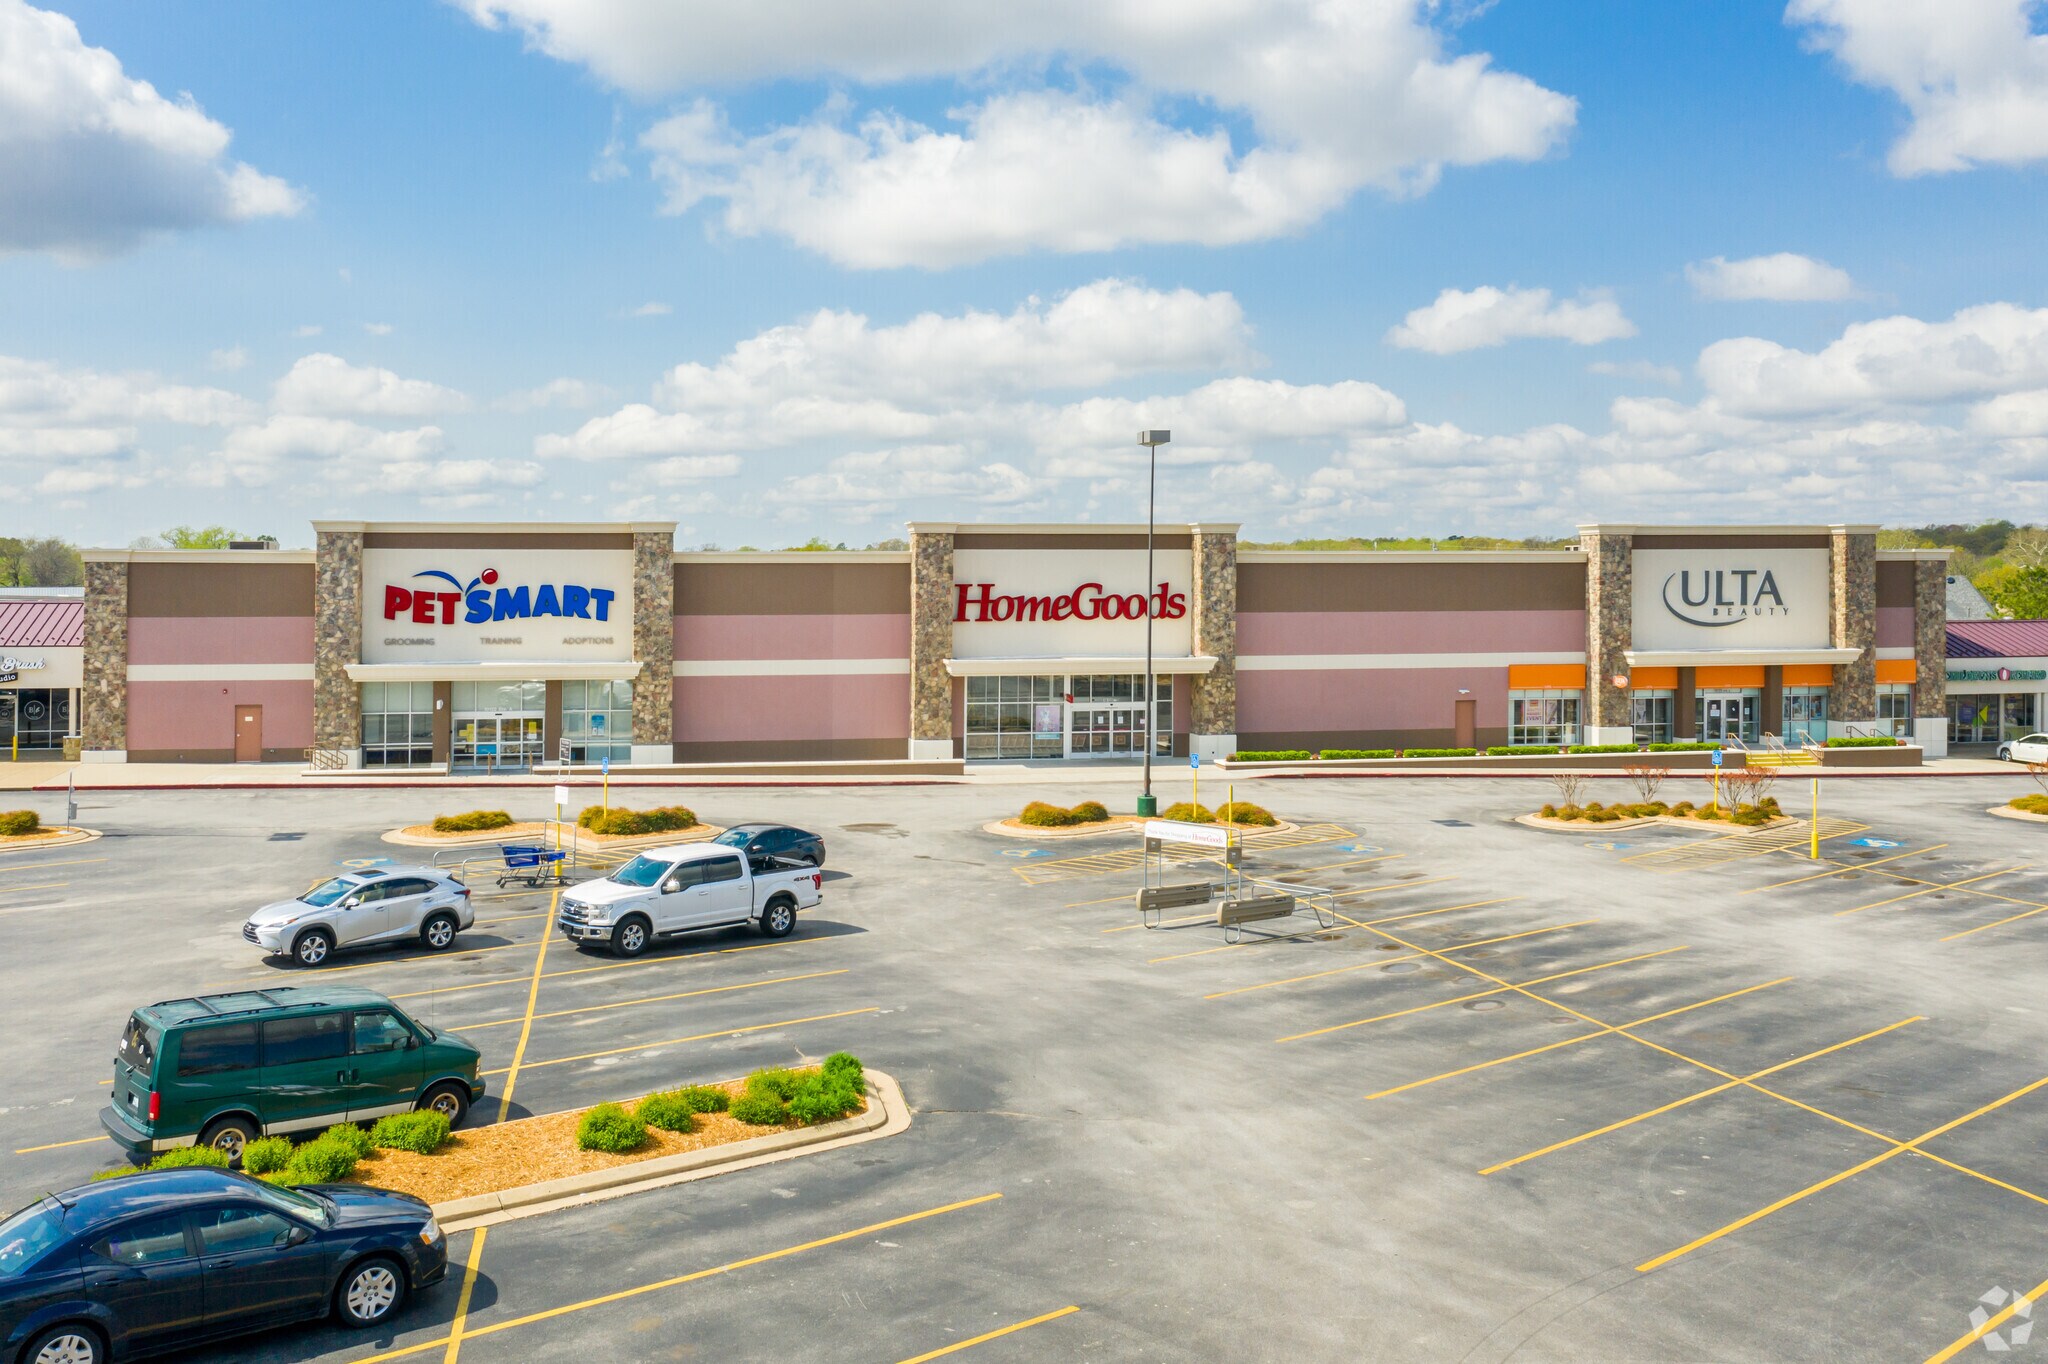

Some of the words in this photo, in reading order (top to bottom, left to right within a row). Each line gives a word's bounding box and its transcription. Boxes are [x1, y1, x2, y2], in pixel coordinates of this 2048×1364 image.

[1681, 570, 1784, 607] ULTA
[953, 582, 1187, 622] HomeGoods
[1713, 608, 1790, 616] BEAUTY
[384, 638, 435, 646] GROOMING
[480, 637, 522, 645] TRAINING
[562, 637, 614, 645] ADOPTIONS
[1, 657, 46, 672] Brush
